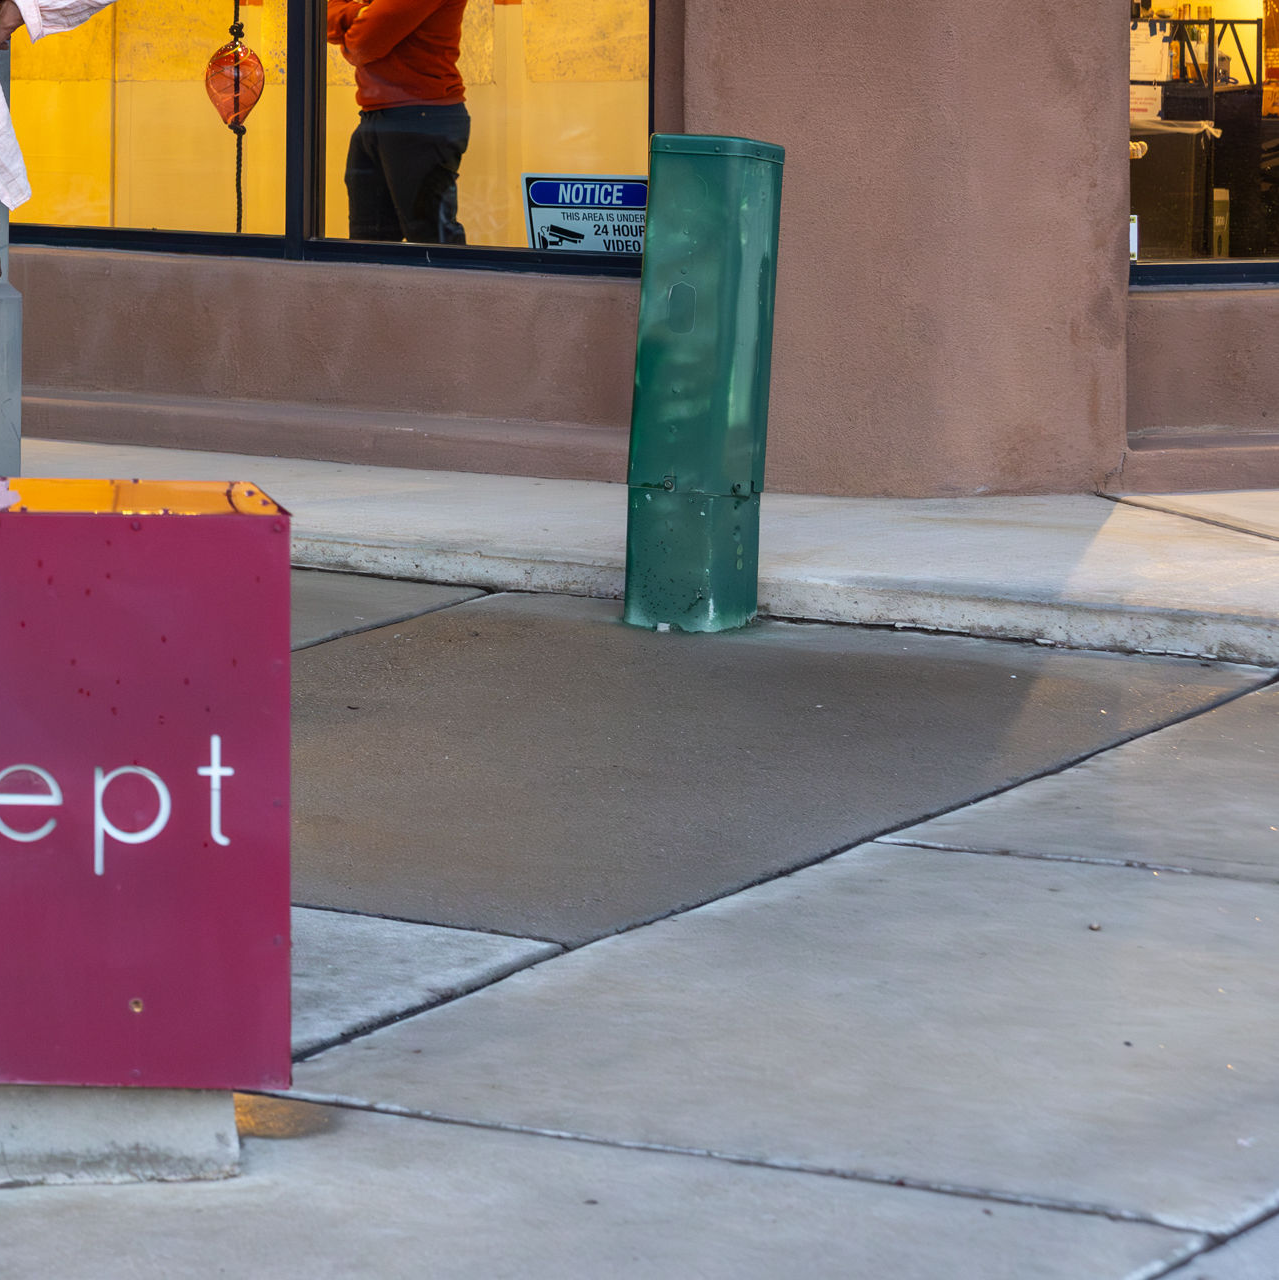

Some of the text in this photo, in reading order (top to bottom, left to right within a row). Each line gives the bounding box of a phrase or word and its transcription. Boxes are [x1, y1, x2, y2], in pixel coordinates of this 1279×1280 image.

[558, 183, 624, 205] NOTICE
[561, 212, 646, 223] THIS AREA IS UNDER
[593, 224, 609, 236] 24
[603, 239, 641, 252] VIDEO
